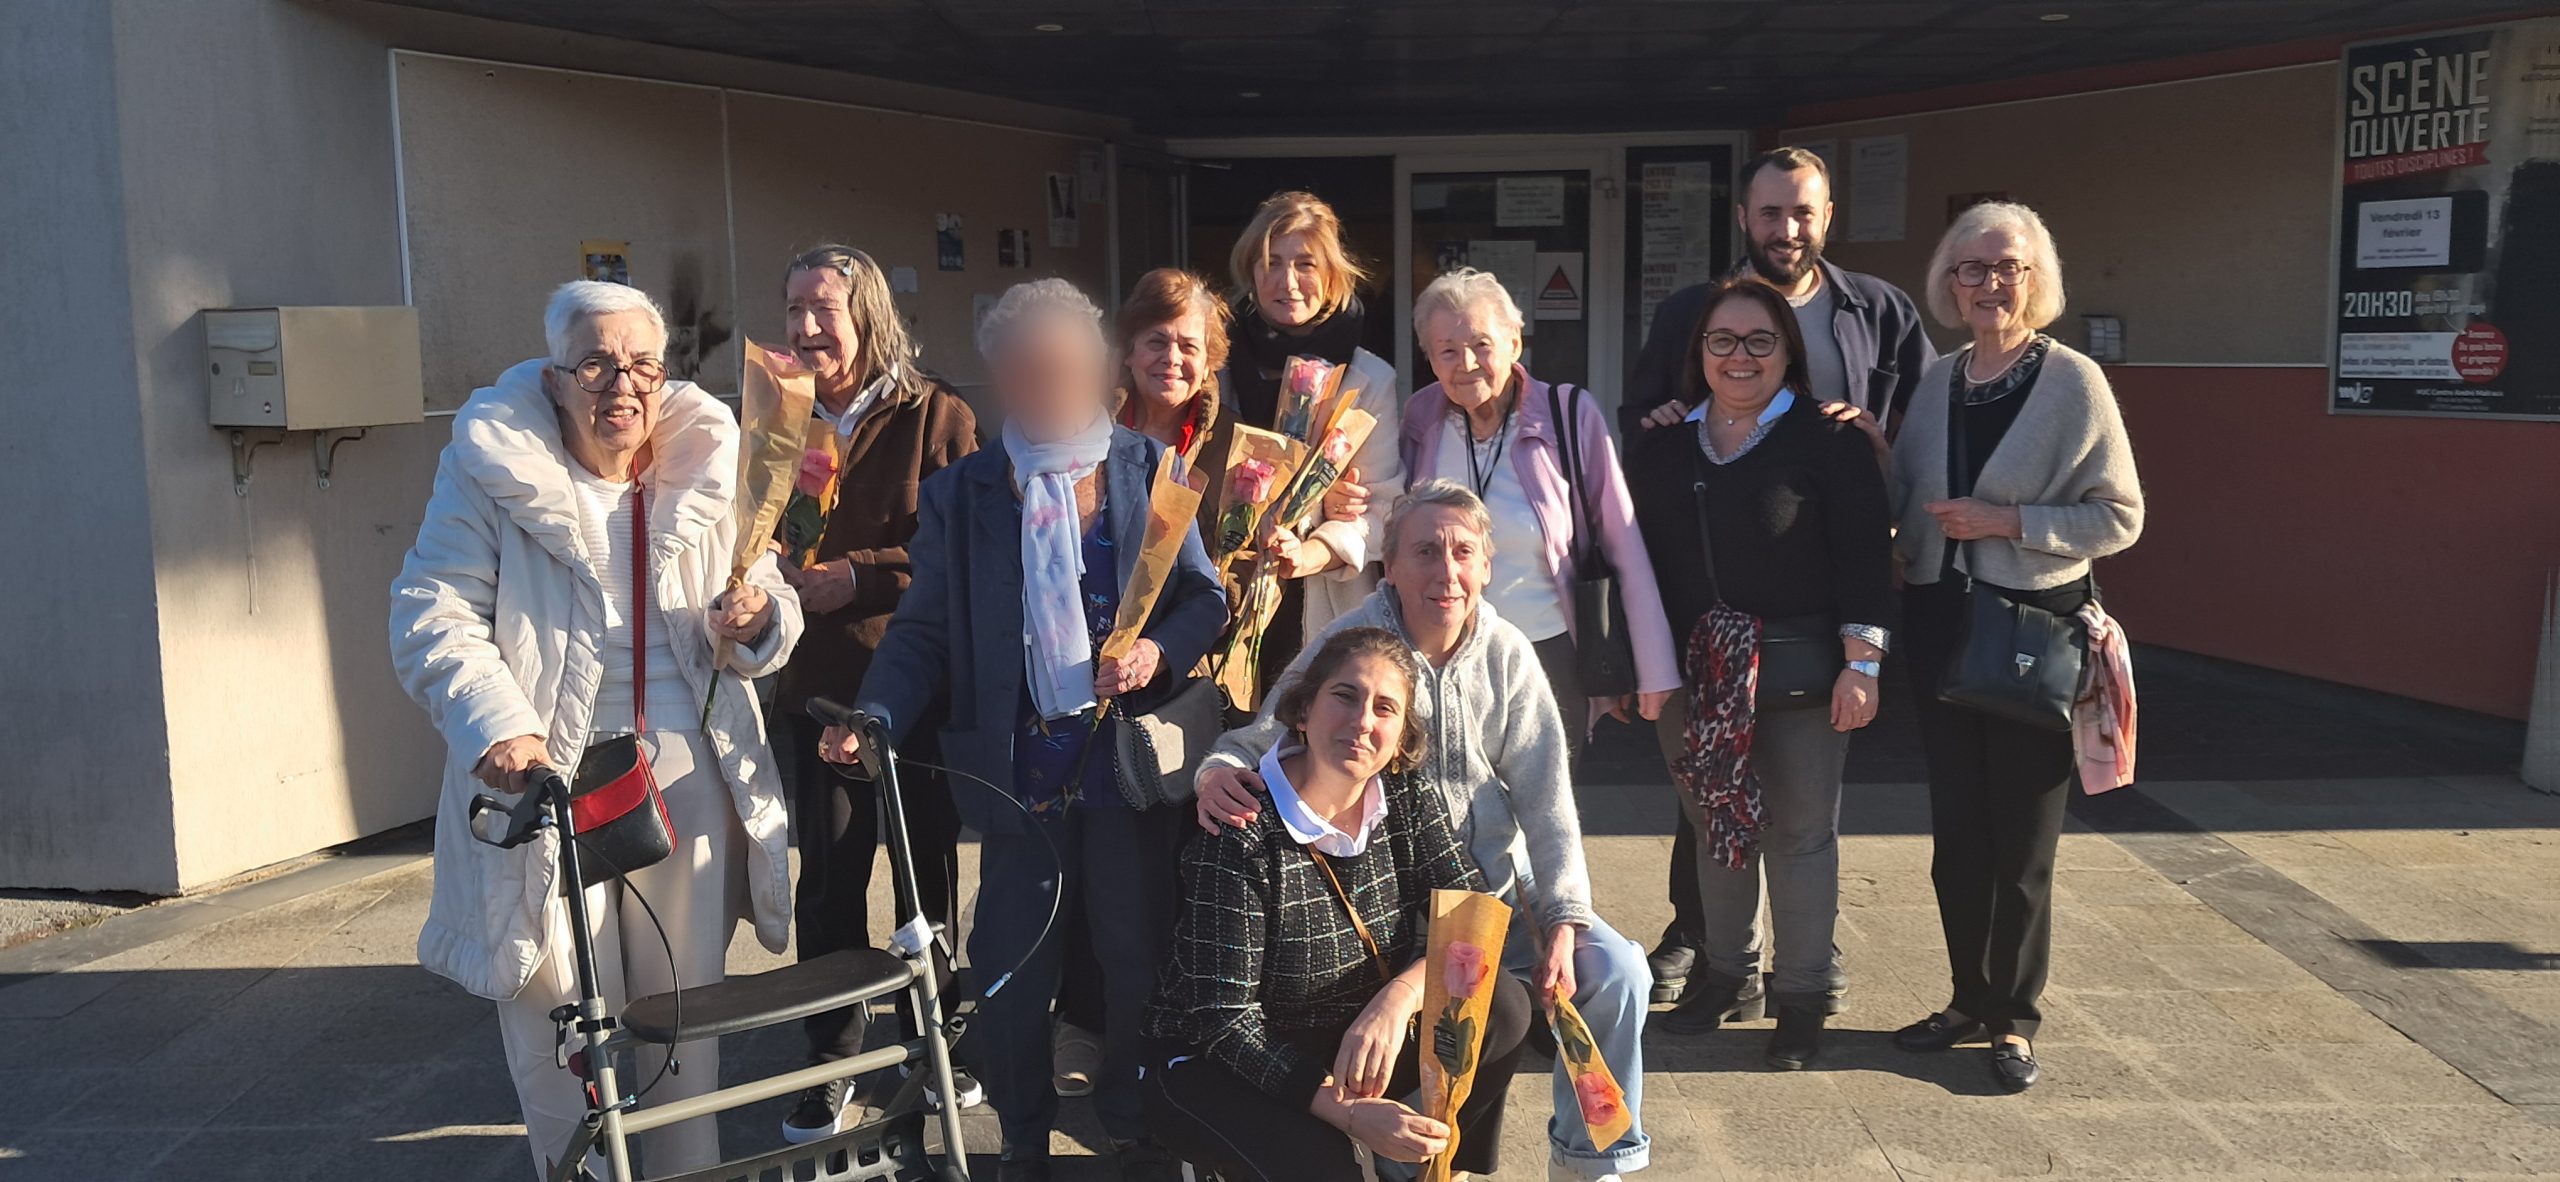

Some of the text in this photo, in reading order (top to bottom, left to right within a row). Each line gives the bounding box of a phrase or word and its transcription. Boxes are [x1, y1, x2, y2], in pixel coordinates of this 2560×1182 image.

[2351, 48, 2490, 118] SCÈNE
[2349, 107, 2491, 158] OUVERTE
[2354, 159, 2394, 180] TOUTES
[2397, 148, 2466, 174] DISCIPLINES
[2370, 209, 2441, 223] Vendredi 13
[2382, 228, 2423, 239] février
[2343, 291, 2413, 318] 20H30
